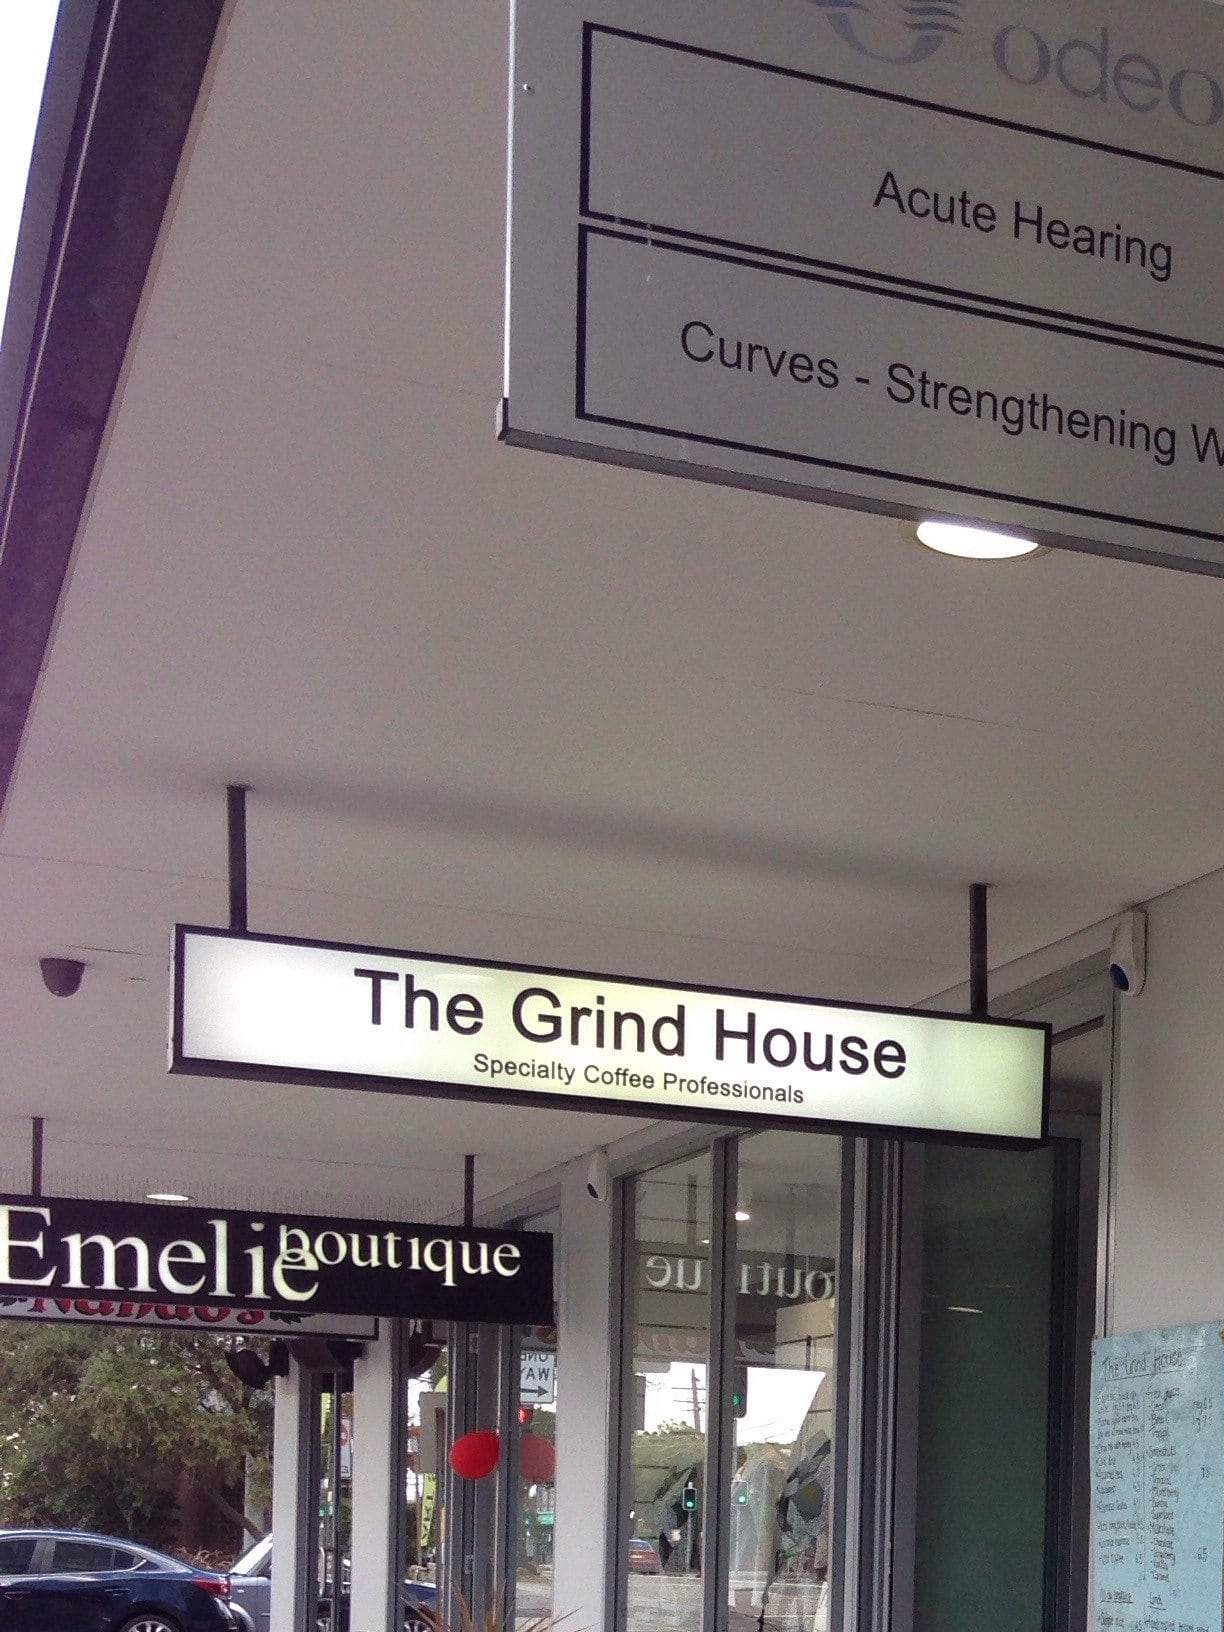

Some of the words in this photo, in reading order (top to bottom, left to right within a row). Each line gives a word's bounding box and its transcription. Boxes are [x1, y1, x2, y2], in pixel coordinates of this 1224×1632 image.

[873, 170, 997, 234] Acute
[1013, 200, 1173, 283] Hearing
[680, 320, 840, 390] Curves
[886, 361, 1177, 467] Strengthening
[352, 966, 484, 1036] The
[511, 987, 686, 1058] Grind
[715, 1008, 907, 1080] House
[473, 1052, 576, 1085] Specialty
[583, 1063, 655, 1089] Coffee
[663, 1071, 805, 1104] Professionals
[0, 1204, 320, 1302] Emelie
[280, 1224, 521, 1288] boutique
